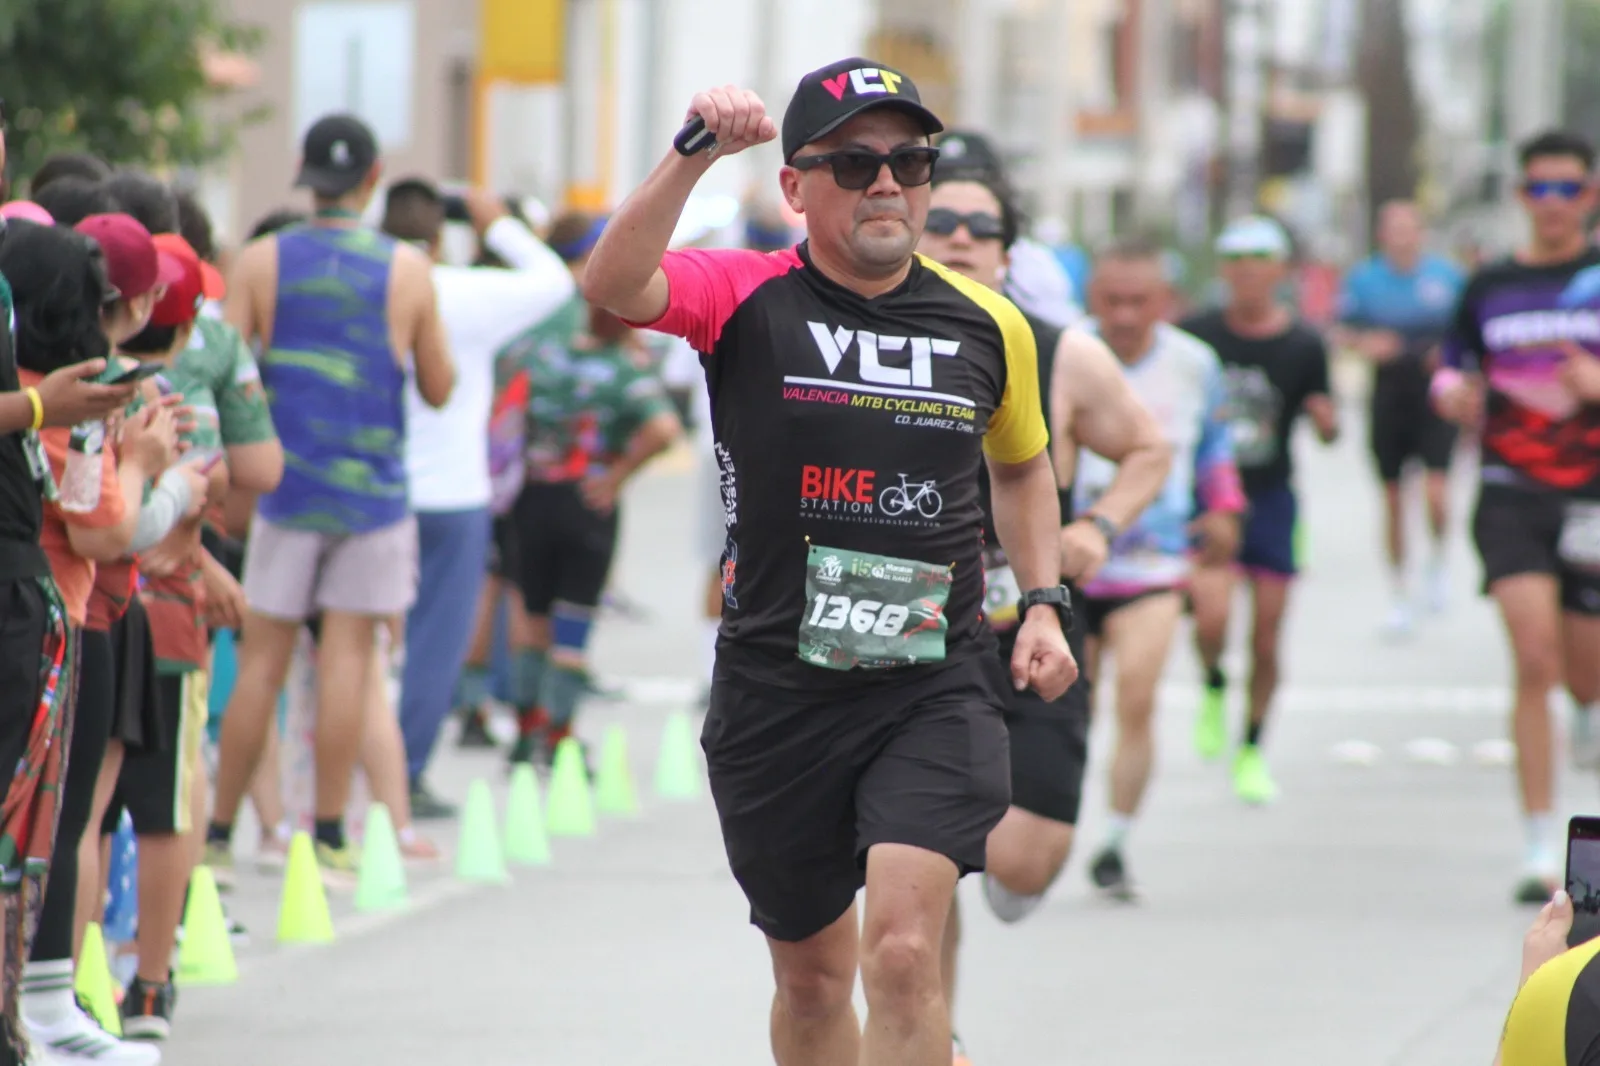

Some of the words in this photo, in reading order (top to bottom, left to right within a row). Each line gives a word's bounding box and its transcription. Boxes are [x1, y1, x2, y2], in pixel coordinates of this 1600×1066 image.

[806, 320, 961, 388] VCT
[783, 386, 849, 405] VALENCIA
[850, 394, 883, 409] MTB
[884, 397, 943, 415] CYCLING
[945, 404, 976, 421] TEAM
[800, 465, 875, 504] BIKE
[799, 496, 874, 515] STATION
[808, 592, 910, 637] 1368
